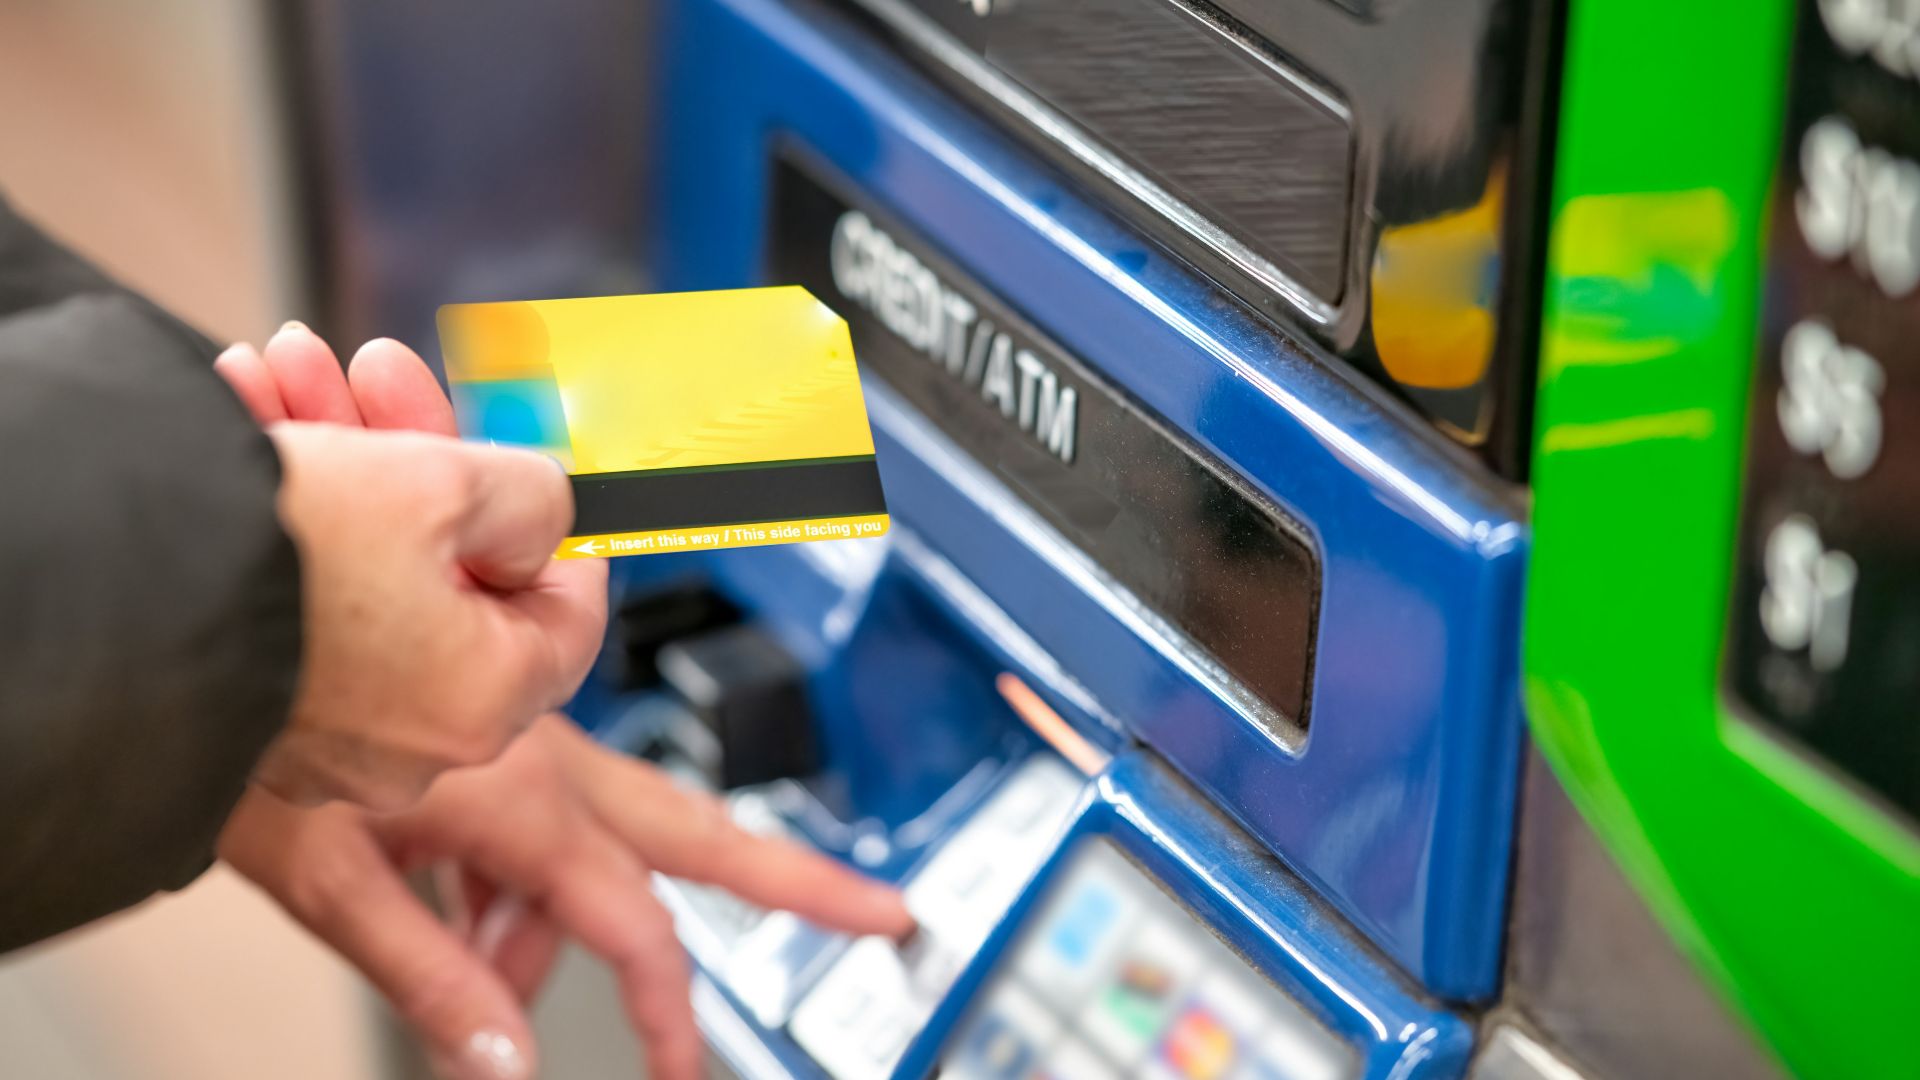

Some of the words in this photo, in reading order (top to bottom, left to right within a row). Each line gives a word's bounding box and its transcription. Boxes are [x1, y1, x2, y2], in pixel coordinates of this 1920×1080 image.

[830, 209, 1076, 465] CREDIT/ATM
[1776, 318, 1886, 479] $5
[609, 537, 655, 551] Insert
[657, 533, 687, 547] this
[690, 532, 720, 546] way
[723, 529, 730, 543] /
[733, 527, 766, 541] This
[769, 524, 801, 539] side
[804, 522, 850, 537] facing
[853, 521, 882, 535] you
